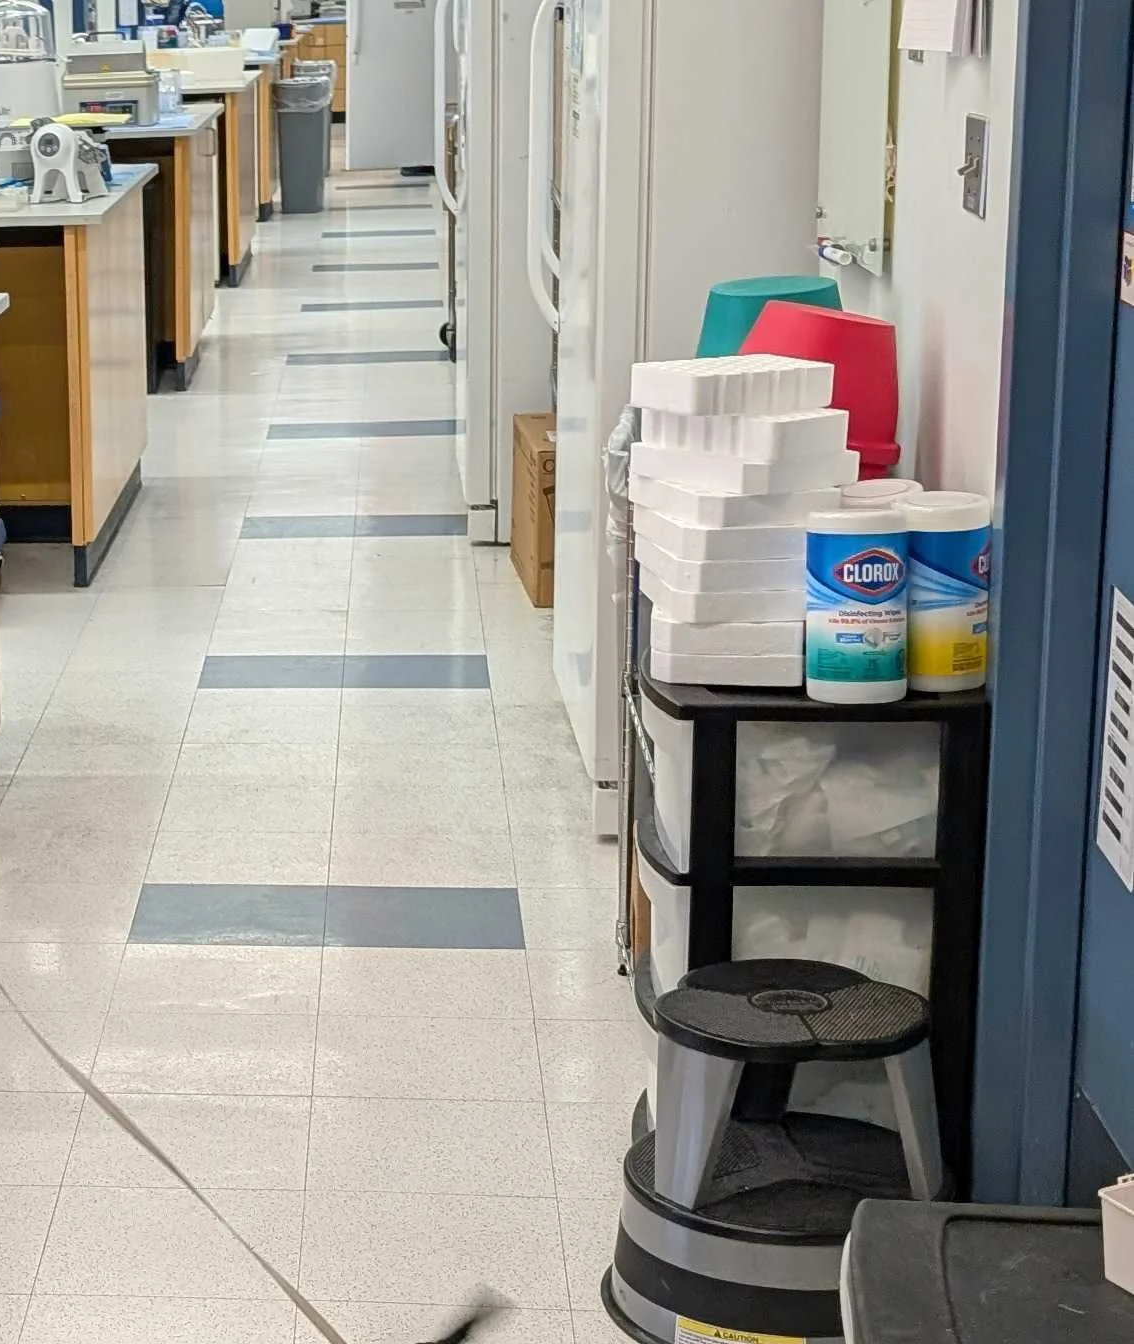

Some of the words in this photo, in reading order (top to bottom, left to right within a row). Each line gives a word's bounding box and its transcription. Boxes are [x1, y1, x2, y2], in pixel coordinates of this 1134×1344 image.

[843, 562, 900, 583] CLOROX
[838, 609, 883, 617] Disinfecting
[723, 1332, 759, 1344] CAUTION
